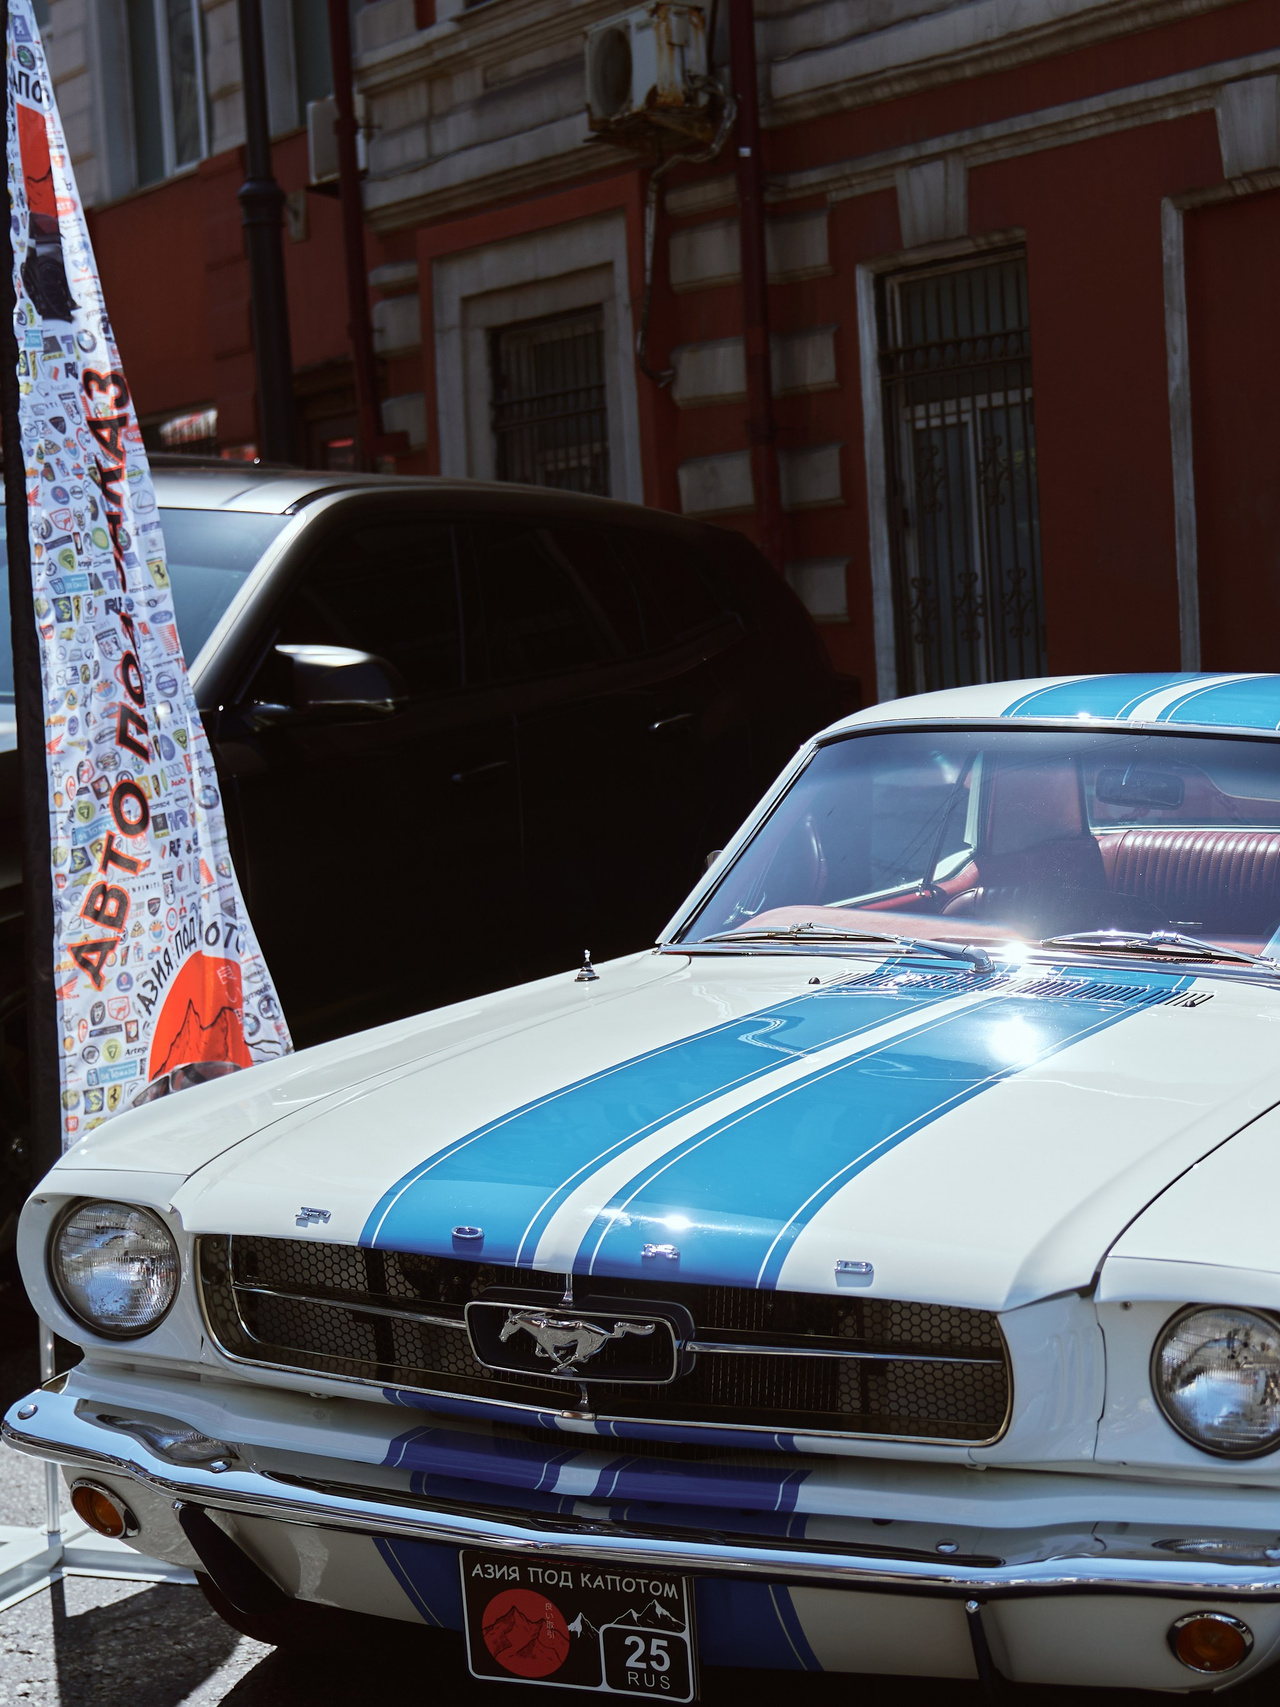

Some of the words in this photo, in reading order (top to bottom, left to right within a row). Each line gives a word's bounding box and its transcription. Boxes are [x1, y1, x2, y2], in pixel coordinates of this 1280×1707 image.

[171, 777, 186, 787] Audi
[67, 779, 151, 992] АВТО
[137, 946, 174, 1016] АЗИЯ
[174, 916, 198, 960] ПОД
[471, 1563, 520, 1581] АЗИЯ
[527, 1567, 573, 1589] ПОД
[580, 1572, 679, 1600] КАПОТОМ
[624, 1635, 671, 1672] 25
[628, 1671, 671, 1690] RUS
